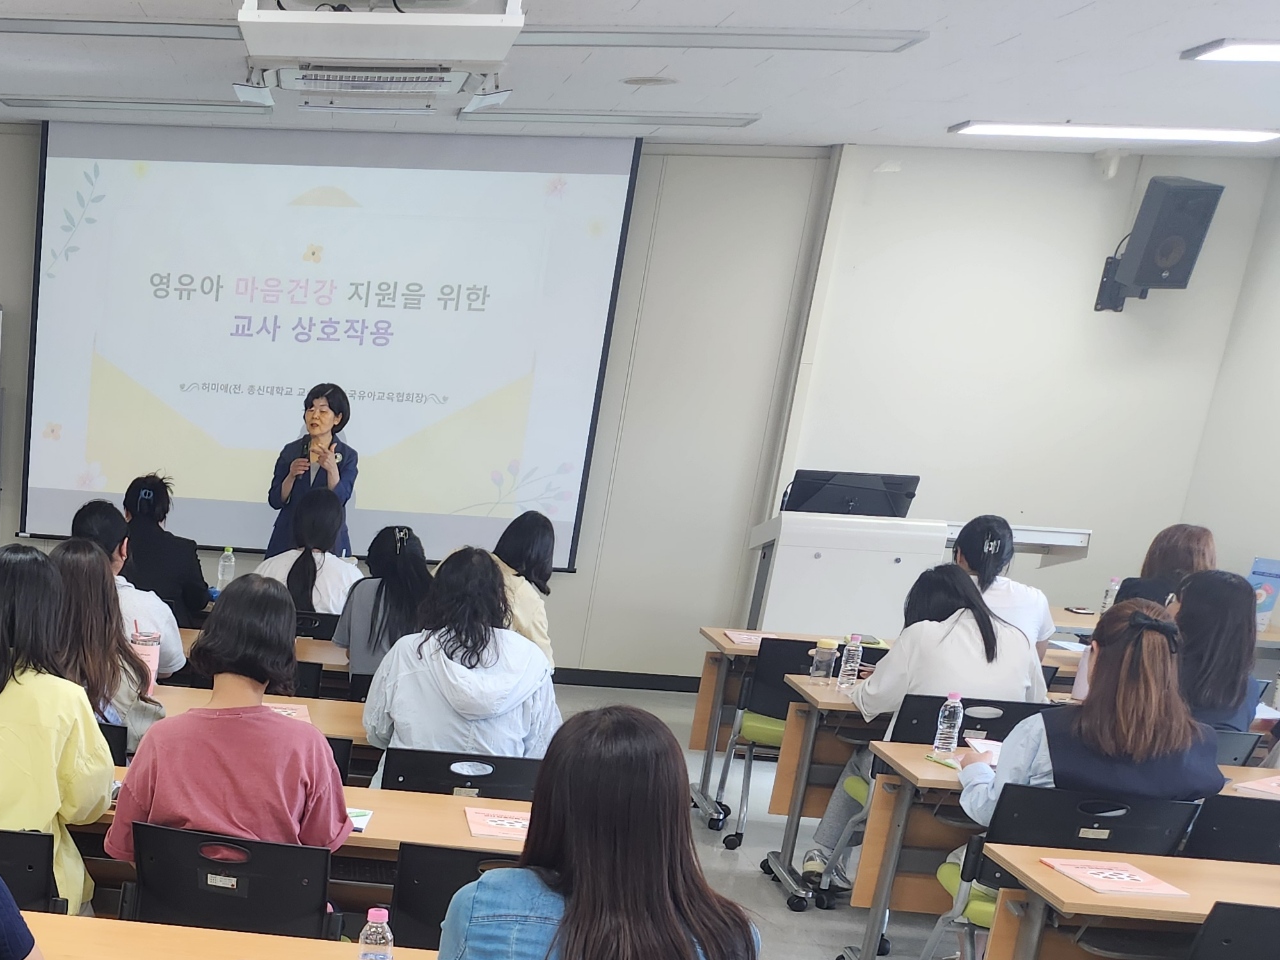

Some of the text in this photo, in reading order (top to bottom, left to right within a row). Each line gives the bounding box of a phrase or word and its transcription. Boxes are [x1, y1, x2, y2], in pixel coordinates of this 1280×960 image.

[149, 272, 491, 312] 영유아 마음건강 지원을 위한
[229, 314, 394, 347] 교사 상호작용
[344, 389, 427, 405] 국유아교육협회장)
